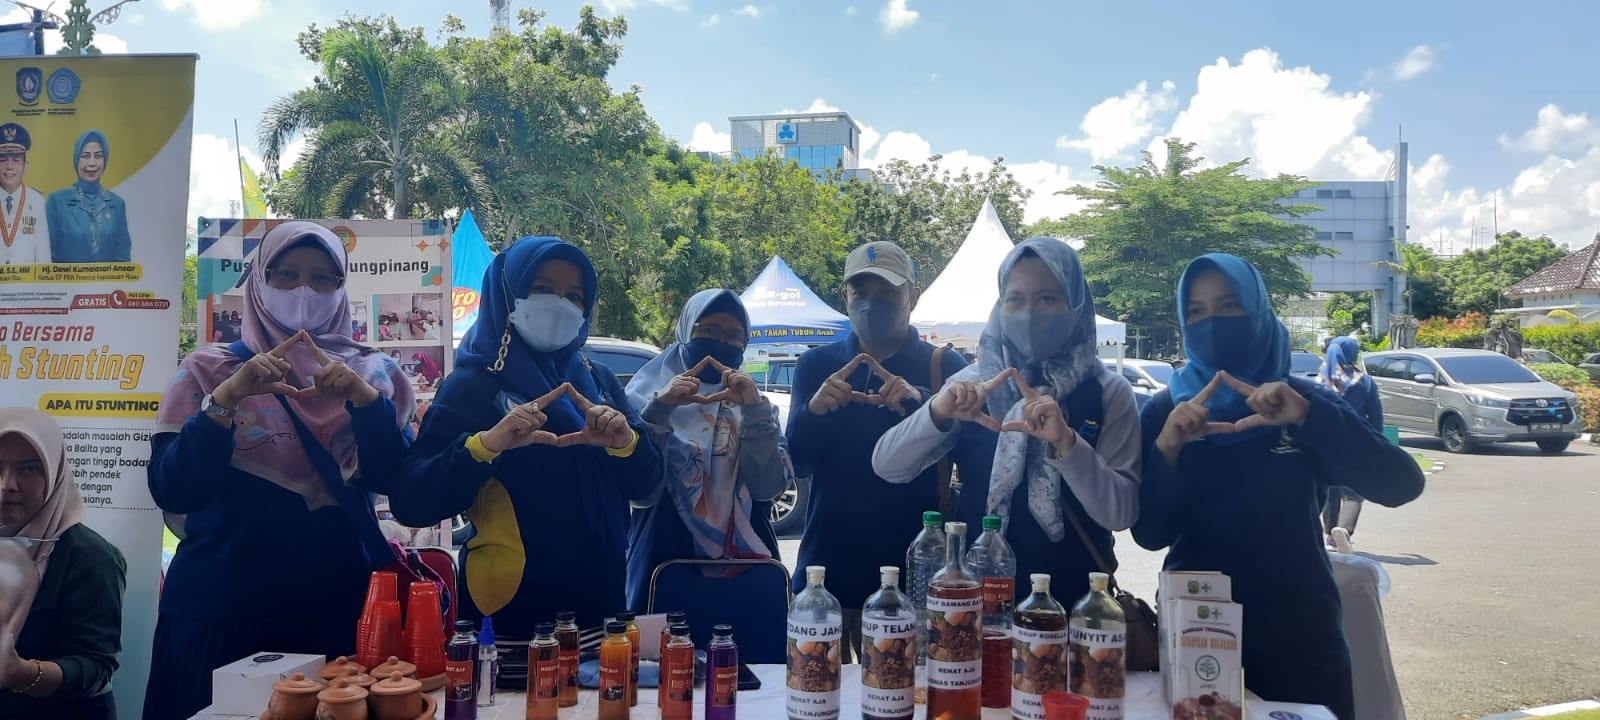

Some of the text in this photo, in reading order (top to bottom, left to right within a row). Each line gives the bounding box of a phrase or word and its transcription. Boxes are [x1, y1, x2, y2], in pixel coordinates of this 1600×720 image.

[113, 264, 136, 272] Ansar
[78, 298, 107, 306] GRATIS
[12, 321, 94, 342] Bersama
[765, 328, 788, 337] TAHAN
[791, 328, 814, 336] TUBUH
[16, 345, 145, 390] Stunting
[46, 400, 159, 412] APA ITU STUNTING
[92, 432, 131, 441] masalah
[133, 432, 152, 441] Gizi
[75, 444, 98, 453] Balita
[100, 446, 122, 456] yang
[93, 457, 117, 468] tinggi
[90, 470, 122, 481] pendek
[81, 482, 113, 494] dengan
[81, 495, 113, 506] sianya.
[790, 695, 827, 705] REHAT AJA
[867, 693, 890, 701] REHAT
